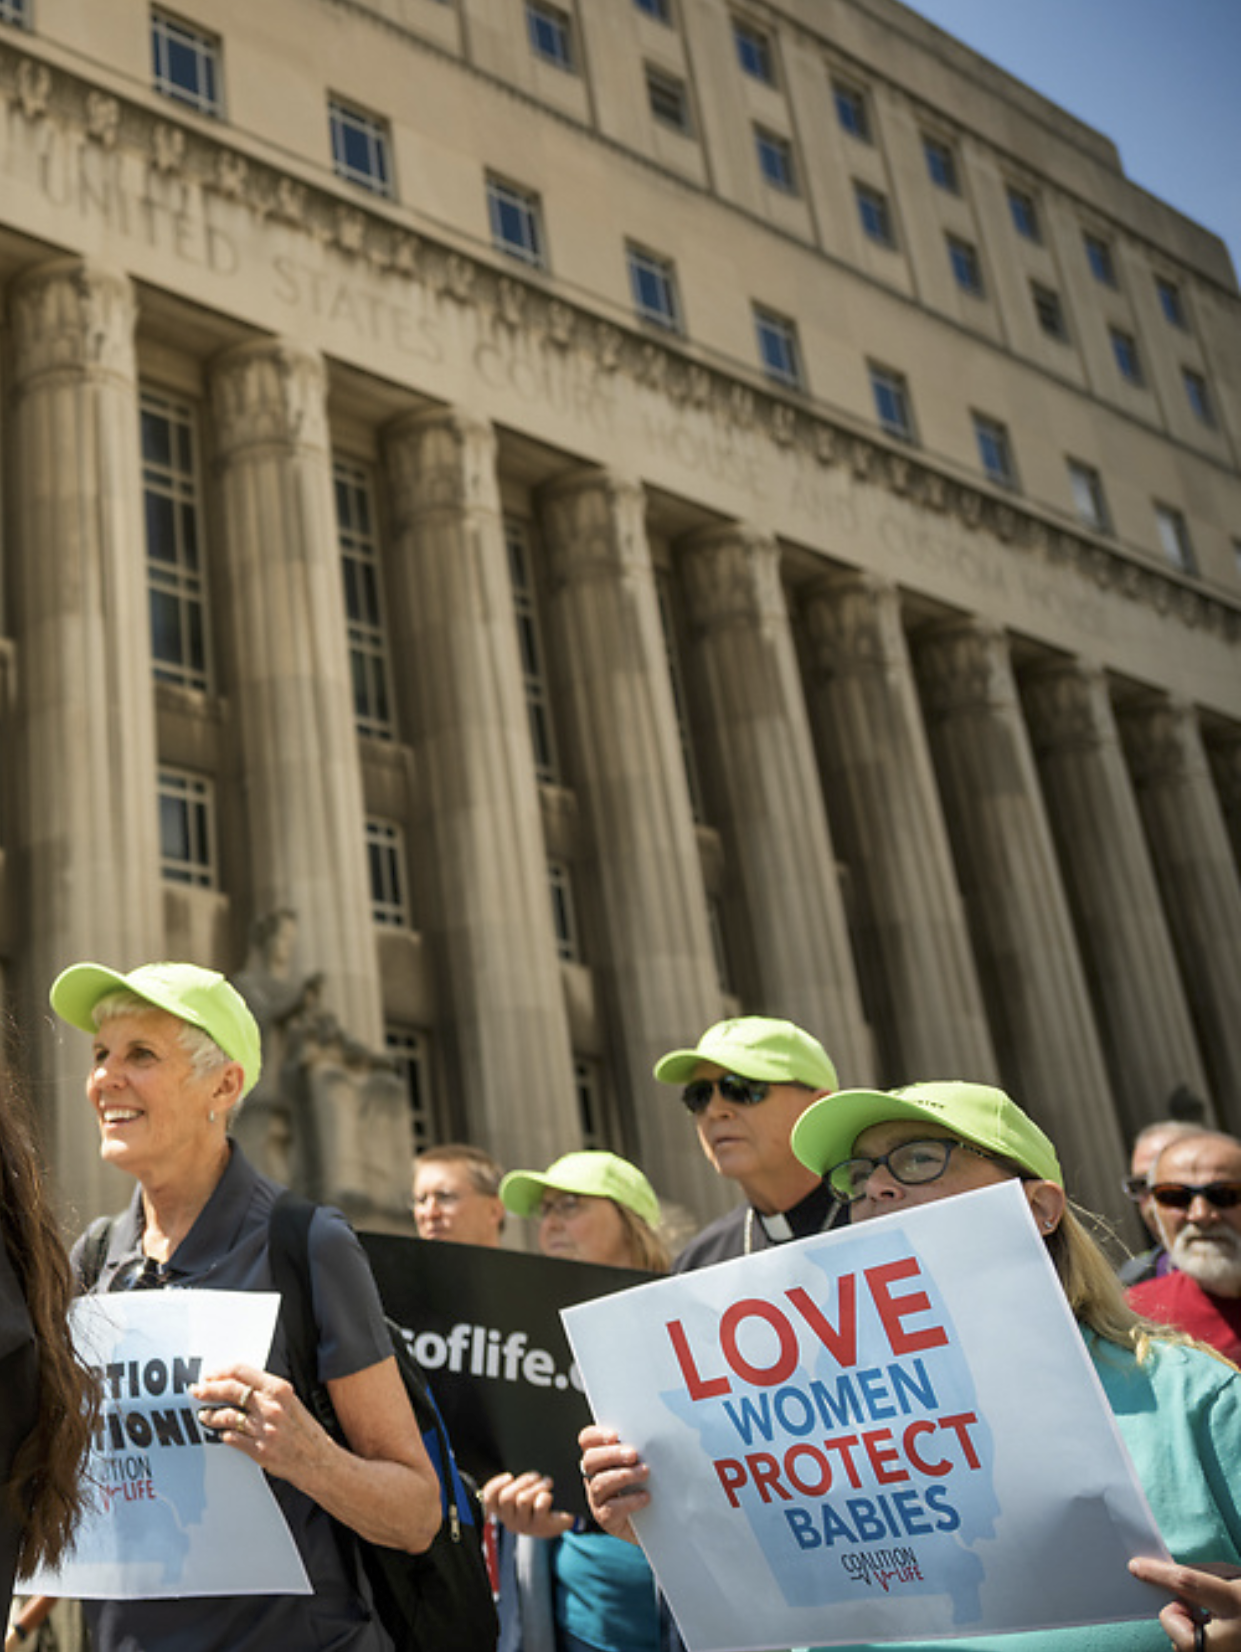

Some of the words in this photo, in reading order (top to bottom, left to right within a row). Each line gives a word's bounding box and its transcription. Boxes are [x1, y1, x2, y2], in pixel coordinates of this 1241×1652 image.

[37, 145, 241, 278] UNITED
[271, 252, 446, 366] STATES
[473, 340, 619, 437] COURT
[666, 1256, 949, 1401] LOVE
[723, 1358, 939, 1446] WOMEN
[101, 1455, 152, 1481] TION
[123, 1479, 158, 1501] LIFE
[713, 1412, 982, 1508] PROTECT
[784, 1485, 961, 1549] BABIES
[841, 1546, 917, 1574] COALITION
